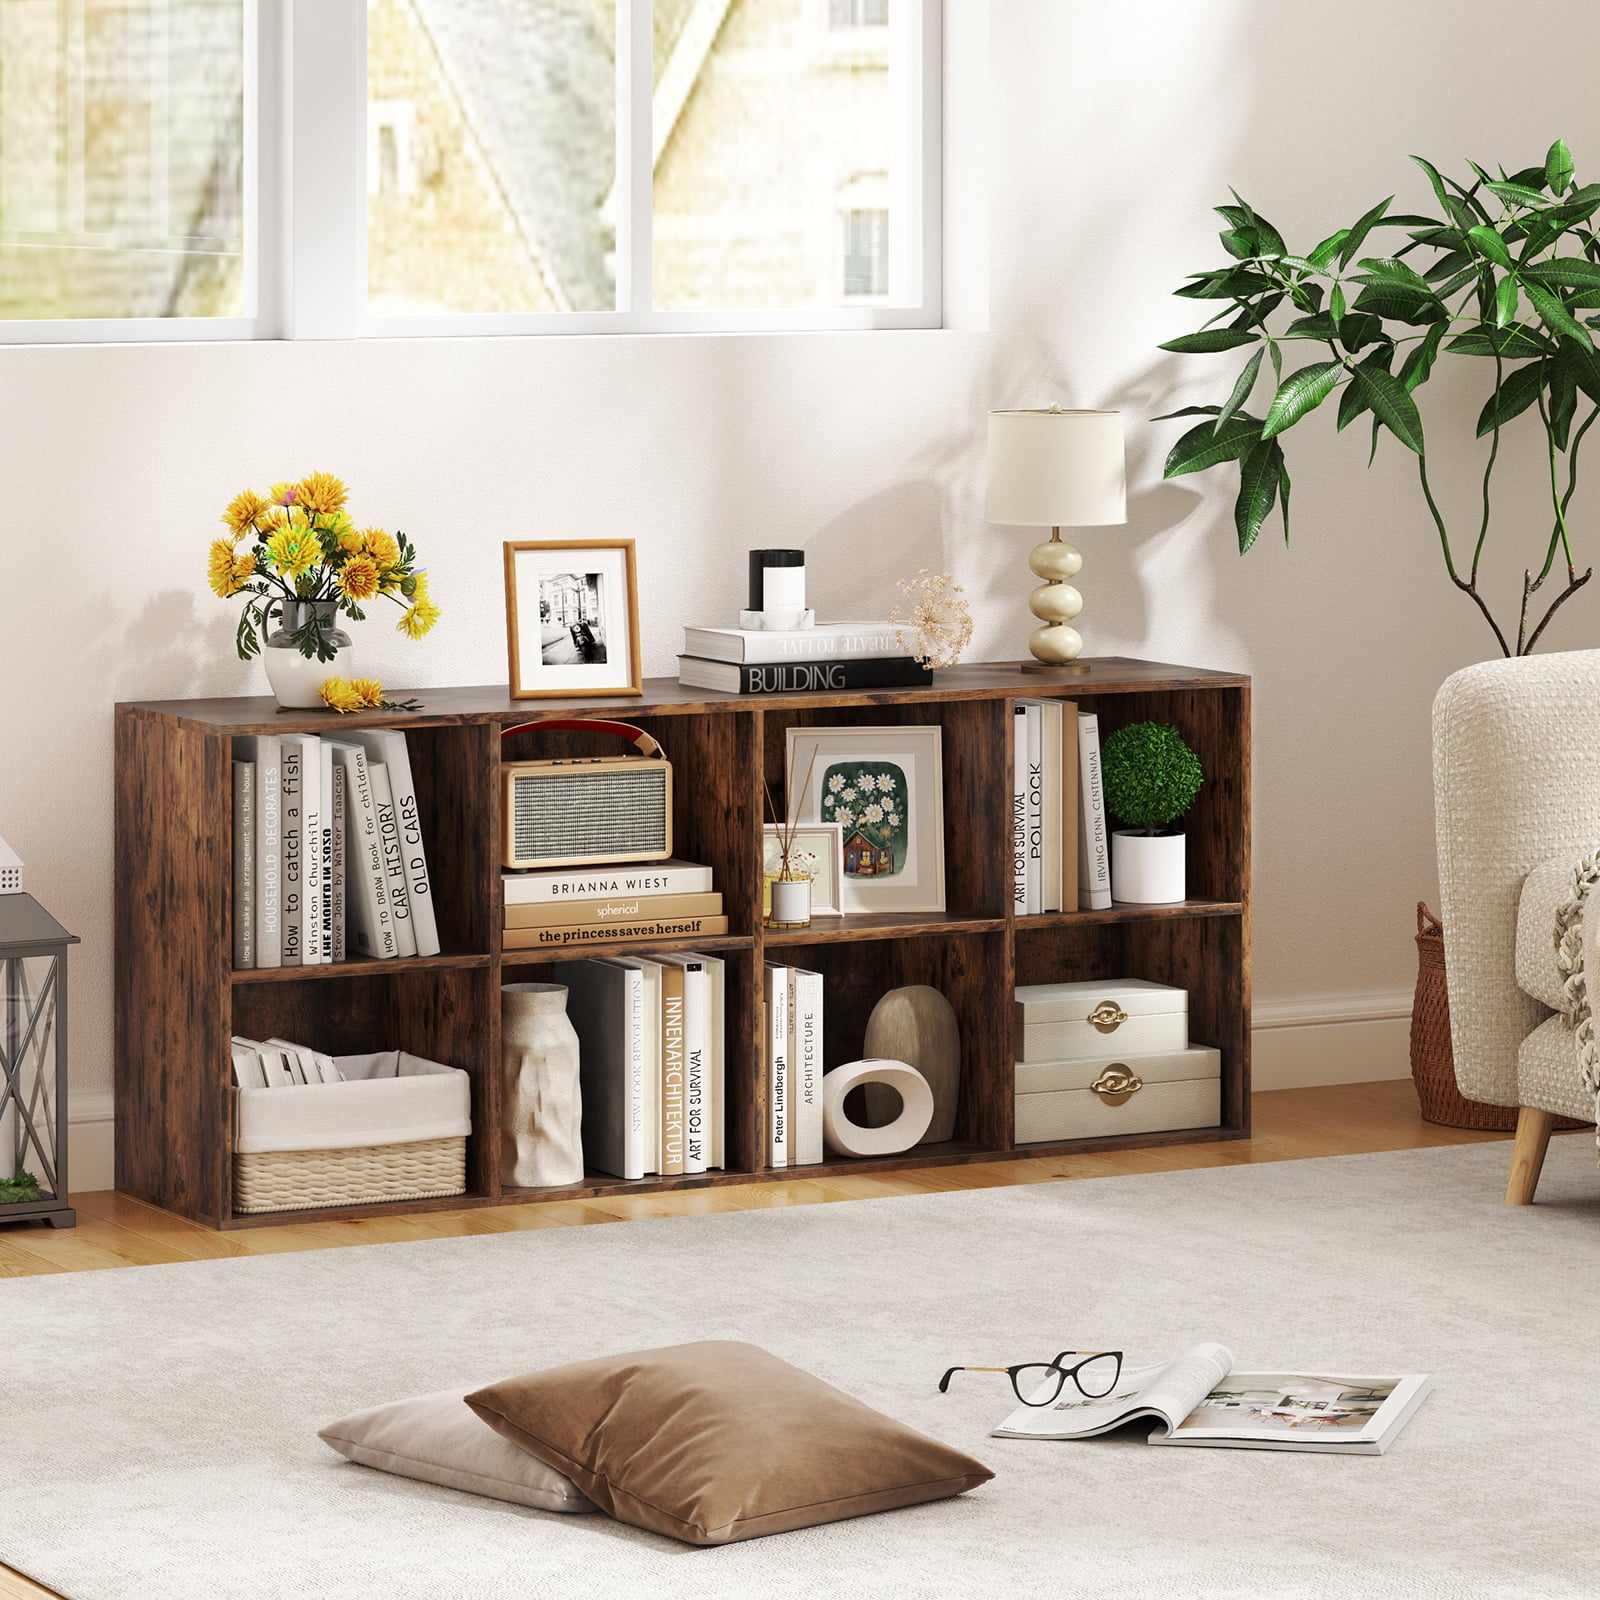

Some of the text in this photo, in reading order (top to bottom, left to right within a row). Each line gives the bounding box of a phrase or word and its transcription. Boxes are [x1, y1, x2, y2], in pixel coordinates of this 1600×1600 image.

[749, 665, 846, 693] BUILDING
[777, 634, 899, 655] CREATE TO LIVE
[242, 797, 250, 812] the
[242, 816, 250, 828] in
[334, 827, 342, 866] Walter
[400, 795, 428, 894] OLD CARS
[1014, 792, 1025, 904] ART FOR SURVIVAL
[1030, 763, 1041, 859] POLLOCK
[1089, 750, 1106, 882] IRVING PENN: CENTENNIAL
[244, 831, 252, 886] arrangement
[265, 767, 277, 932] HOUSEHOLD DECORATES
[283, 754, 298, 957] How to catch a fish
[309, 812, 318, 955] Winston Churchill
[334, 873, 343, 886] by
[355, 753, 394, 953] HOW TO DRAW Book for children
[377, 803, 409, 919] CAR HISTORY
[552, 877, 668, 895] BRIANNA WIEST
[244, 891, 250, 902] an
[244, 932, 250, 940] to
[334, 892, 342, 918] Jobs
[539, 921, 702, 944] the princess saves herself
[597, 901, 639, 918] spherical
[633, 980, 641, 1132] NEW LOOK REVOLUTION
[666, 996, 682, 1164] INNENARCHITEKTUR
[774, 1056, 786, 1143] Peter Lindbergh
[804, 1013, 813, 1104] ARCHITECTURE
[689, 1049, 701, 1160] ART FOR SURVIVAL
